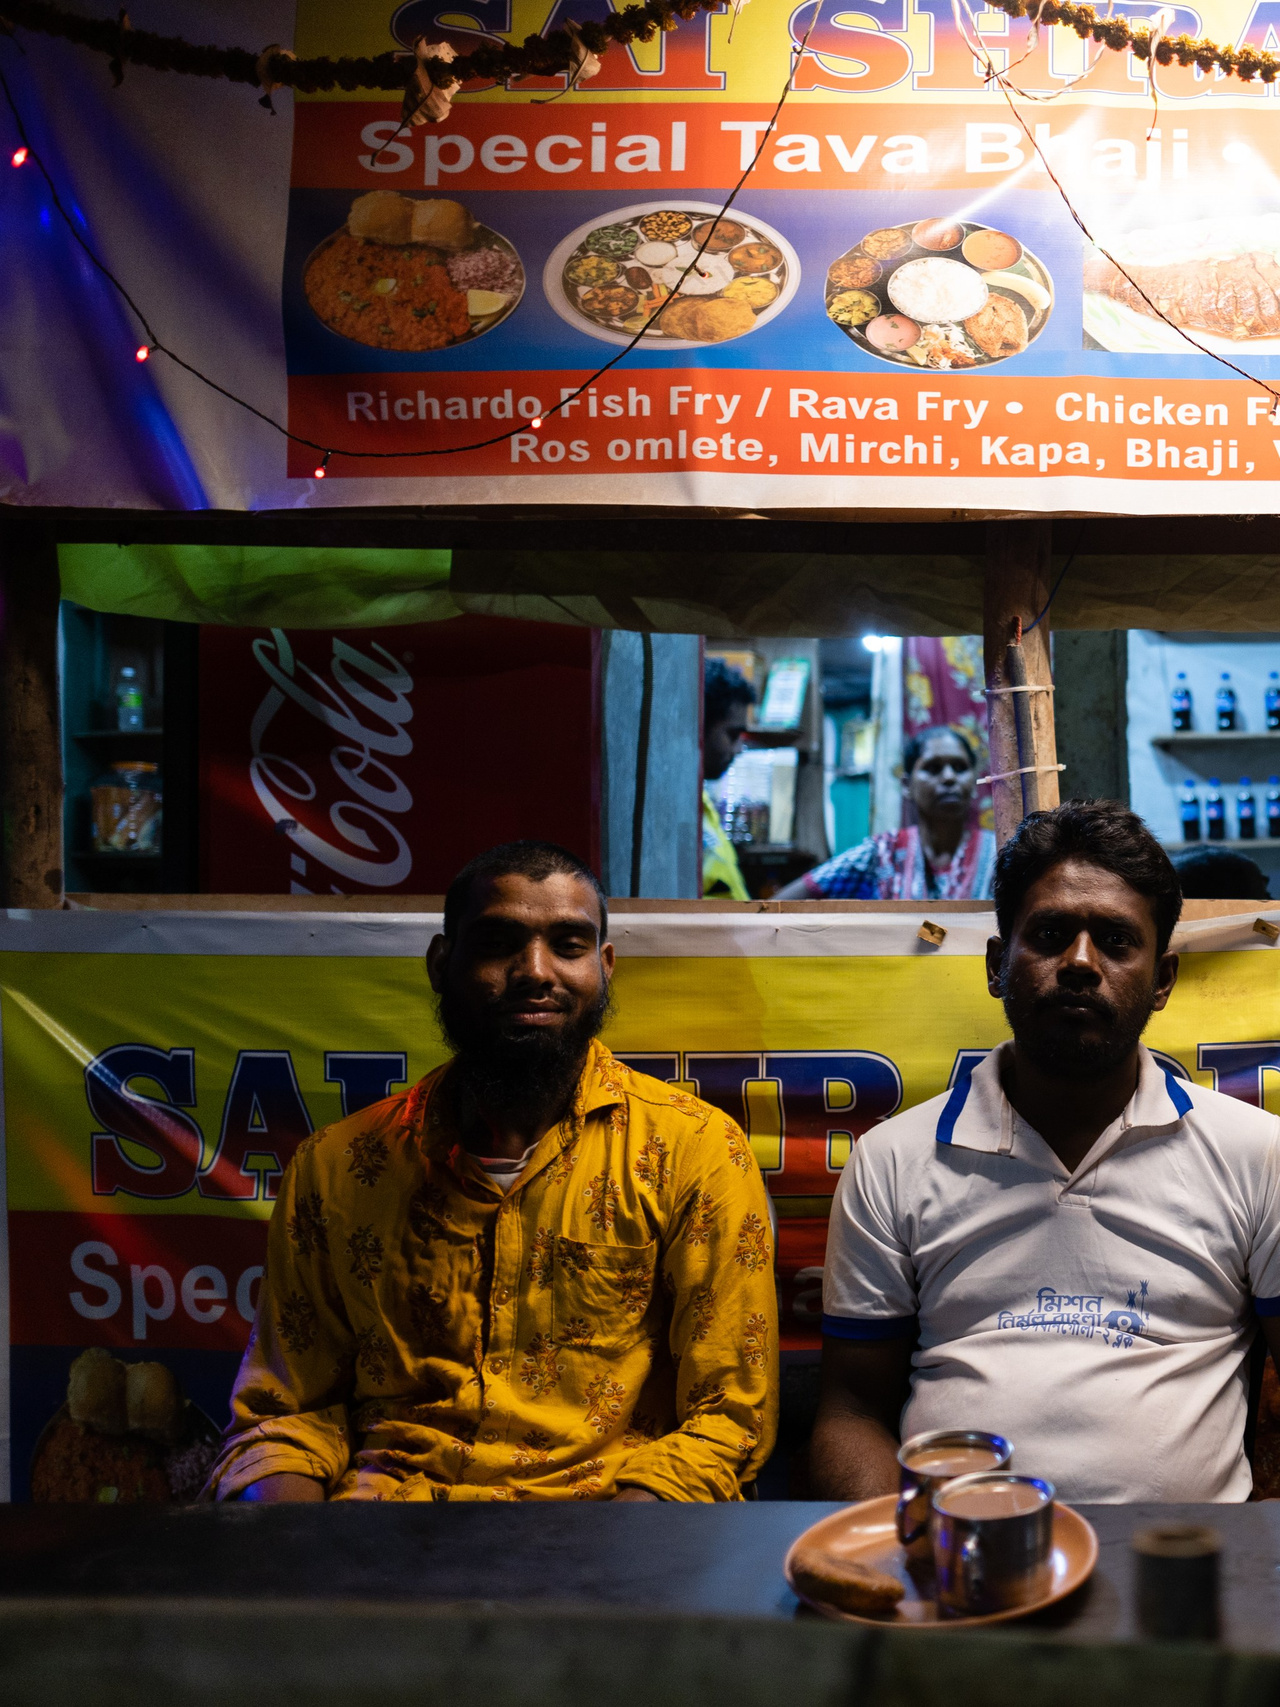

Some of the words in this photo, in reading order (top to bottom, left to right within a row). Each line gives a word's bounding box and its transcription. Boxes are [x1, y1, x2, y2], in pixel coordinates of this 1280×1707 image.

[359, 120, 687, 187] Special
[720, 120, 930, 175] Tava
[965, 121, 1189, 186] Bhaji
[348, 389, 543, 422] Richardo
[559, 386, 652, 419] Fish
[669, 385, 742, 428] Fry
[788, 388, 904, 421] Rava
[916, 390, 990, 430] Fry
[1054, 392, 1230, 427] Chicken
[508, 432, 592, 466] Ros
[606, 430, 779, 469] omlete,
[800, 433, 961, 471] Mirchi,
[980, 436, 1105, 474] Kapa,
[1126, 437, 1255, 478] Bhaji,
[1036, 1286, 1104, 1313] মিশন
